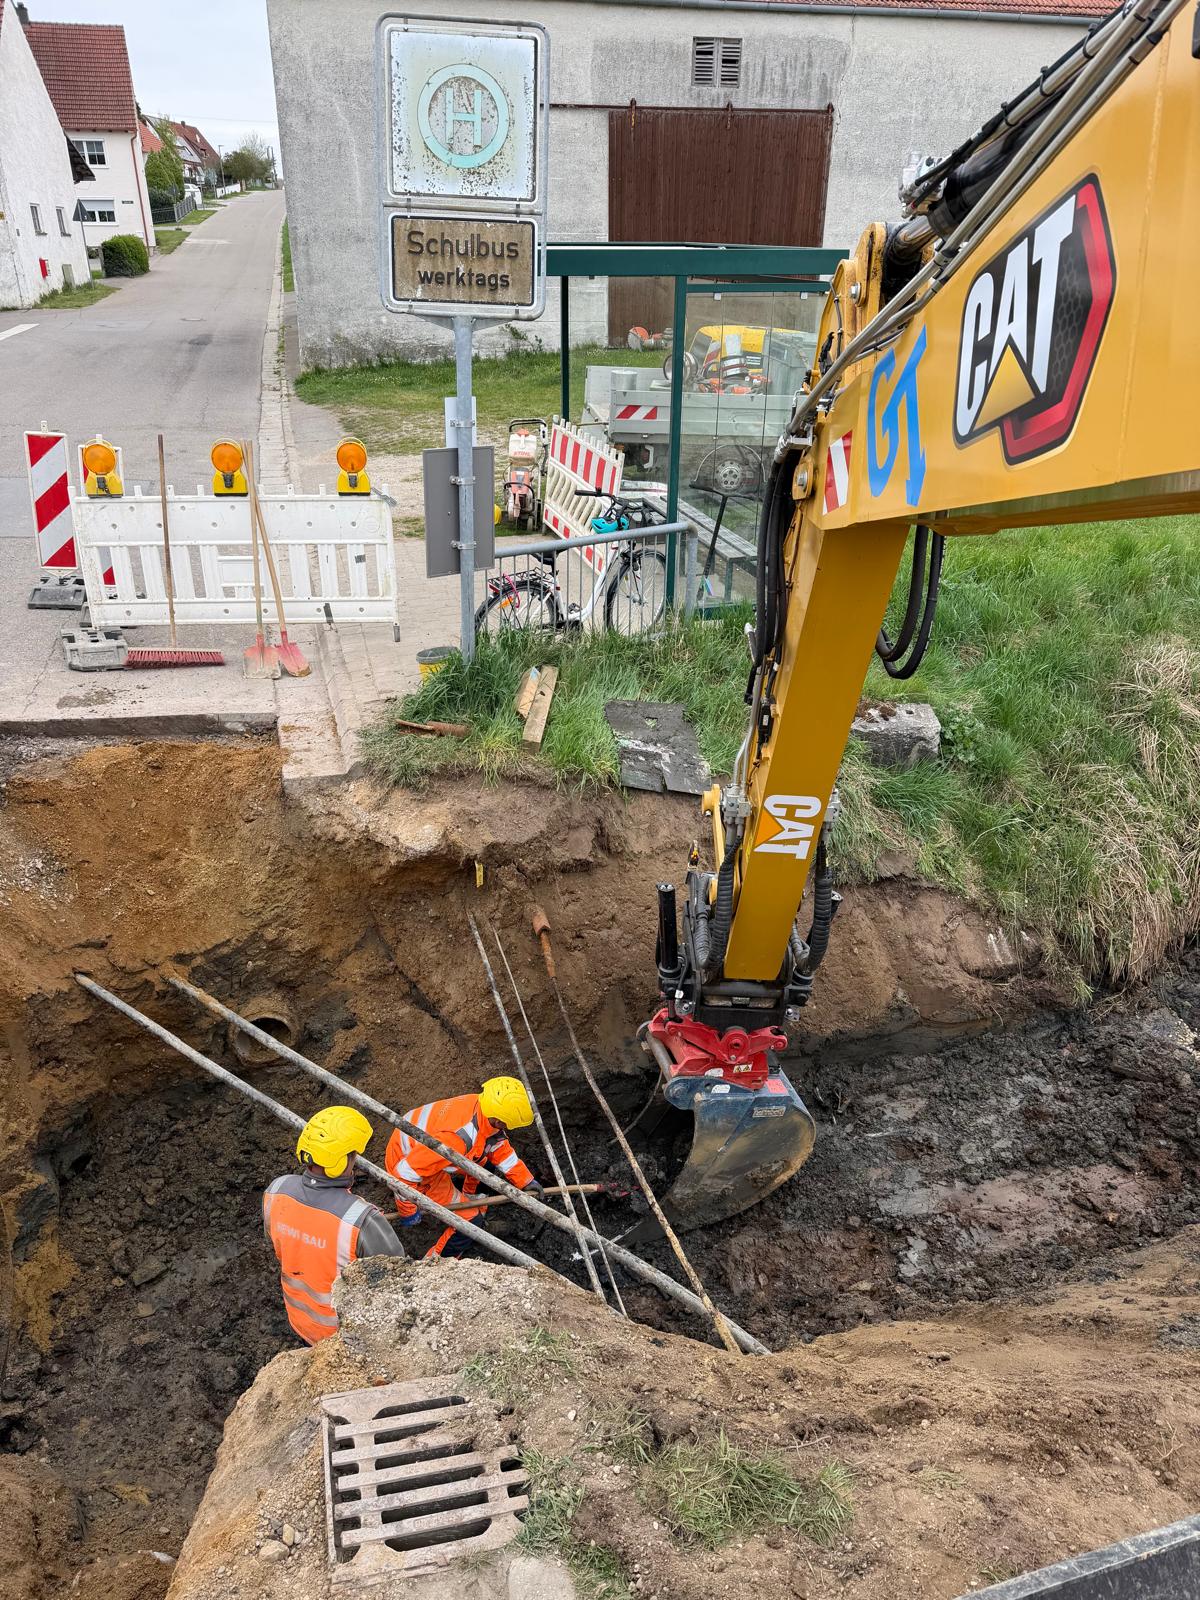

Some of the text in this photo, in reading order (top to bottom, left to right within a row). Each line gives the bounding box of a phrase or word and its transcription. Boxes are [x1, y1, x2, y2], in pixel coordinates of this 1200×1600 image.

[445, 86, 483, 146] H
[407, 230, 519, 259] Schulbus
[417, 267, 510, 291] werktags
[955, 194, 1077, 437] CAT
[753, 794, 822, 859] CAT
[302, 1232, 328, 1249] BAU
